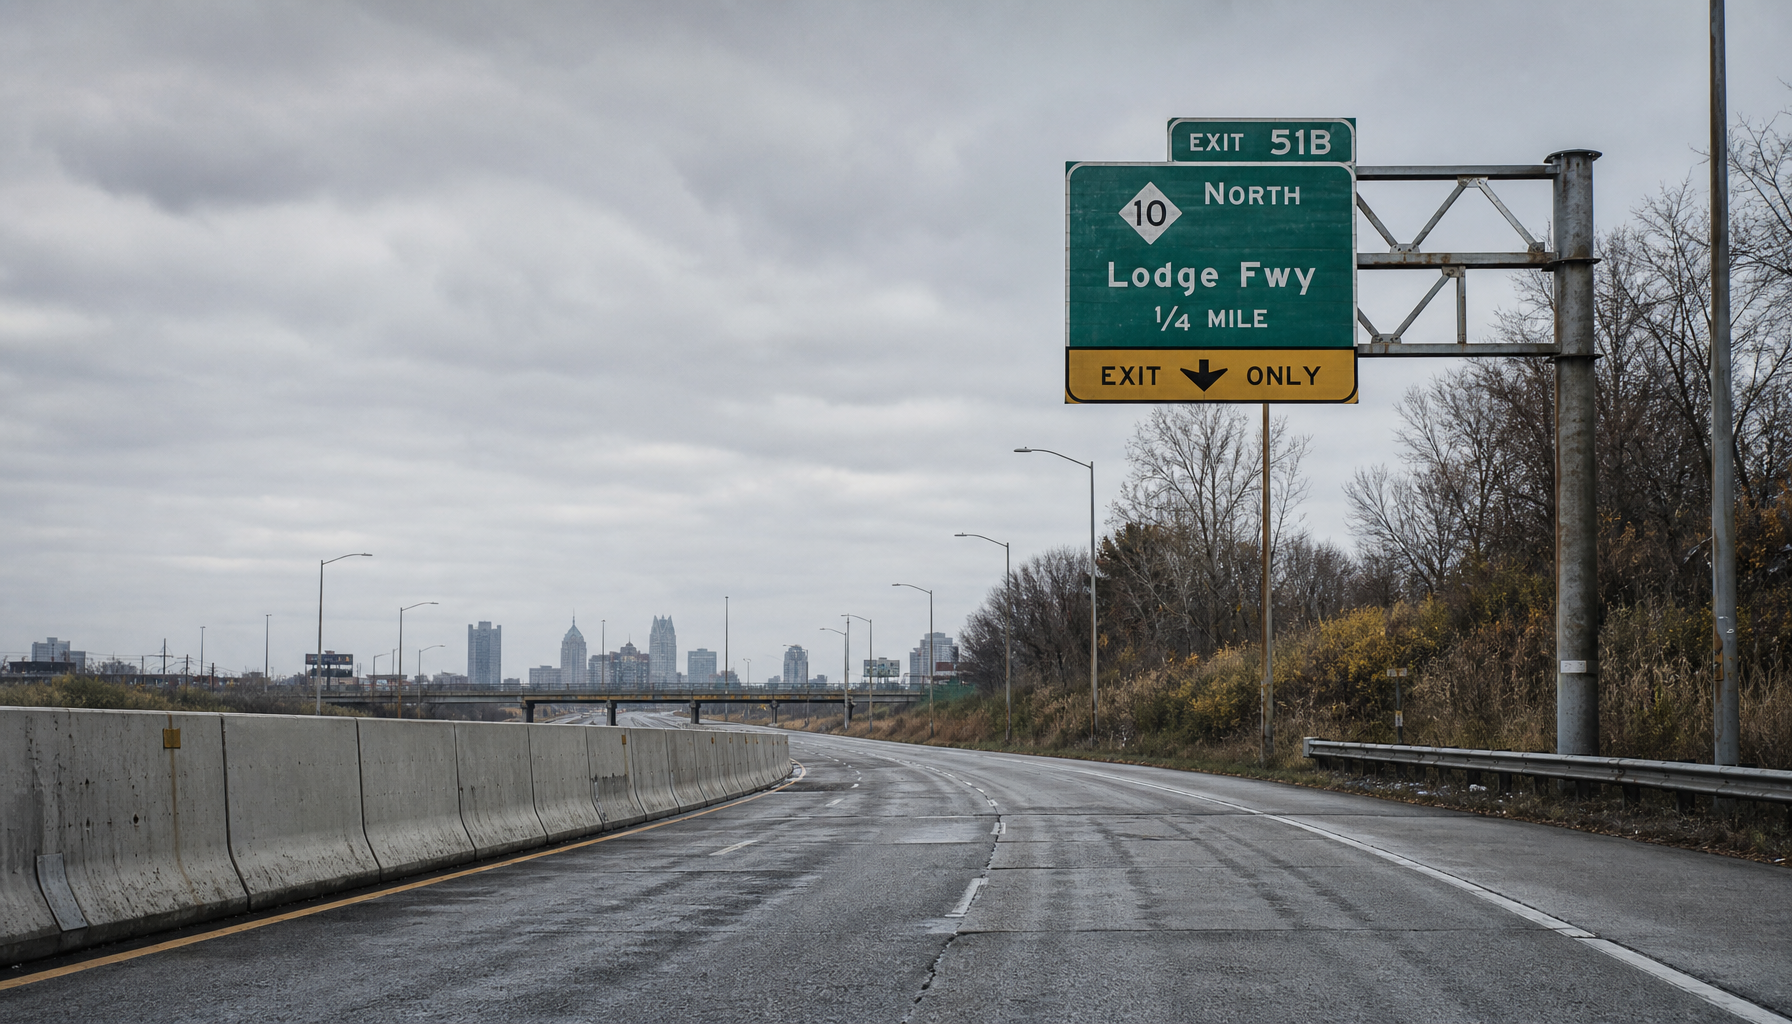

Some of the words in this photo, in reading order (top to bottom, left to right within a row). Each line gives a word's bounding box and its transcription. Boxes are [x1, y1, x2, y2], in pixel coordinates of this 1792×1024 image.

[1190, 133, 1244, 151] EXIT
[1270, 129, 1331, 155] 51B
[1204, 182, 1300, 205] NORTH
[1133, 199, 1167, 227] 10
[1108, 261, 1219, 296] Lodge
[1240, 261, 1316, 295] Fwy
[1154, 305, 1191, 331] 1/4
[1208, 309, 1268, 328] MILE
[1102, 366, 1161, 385] EXIT
[1246, 366, 1321, 385] ONLY
